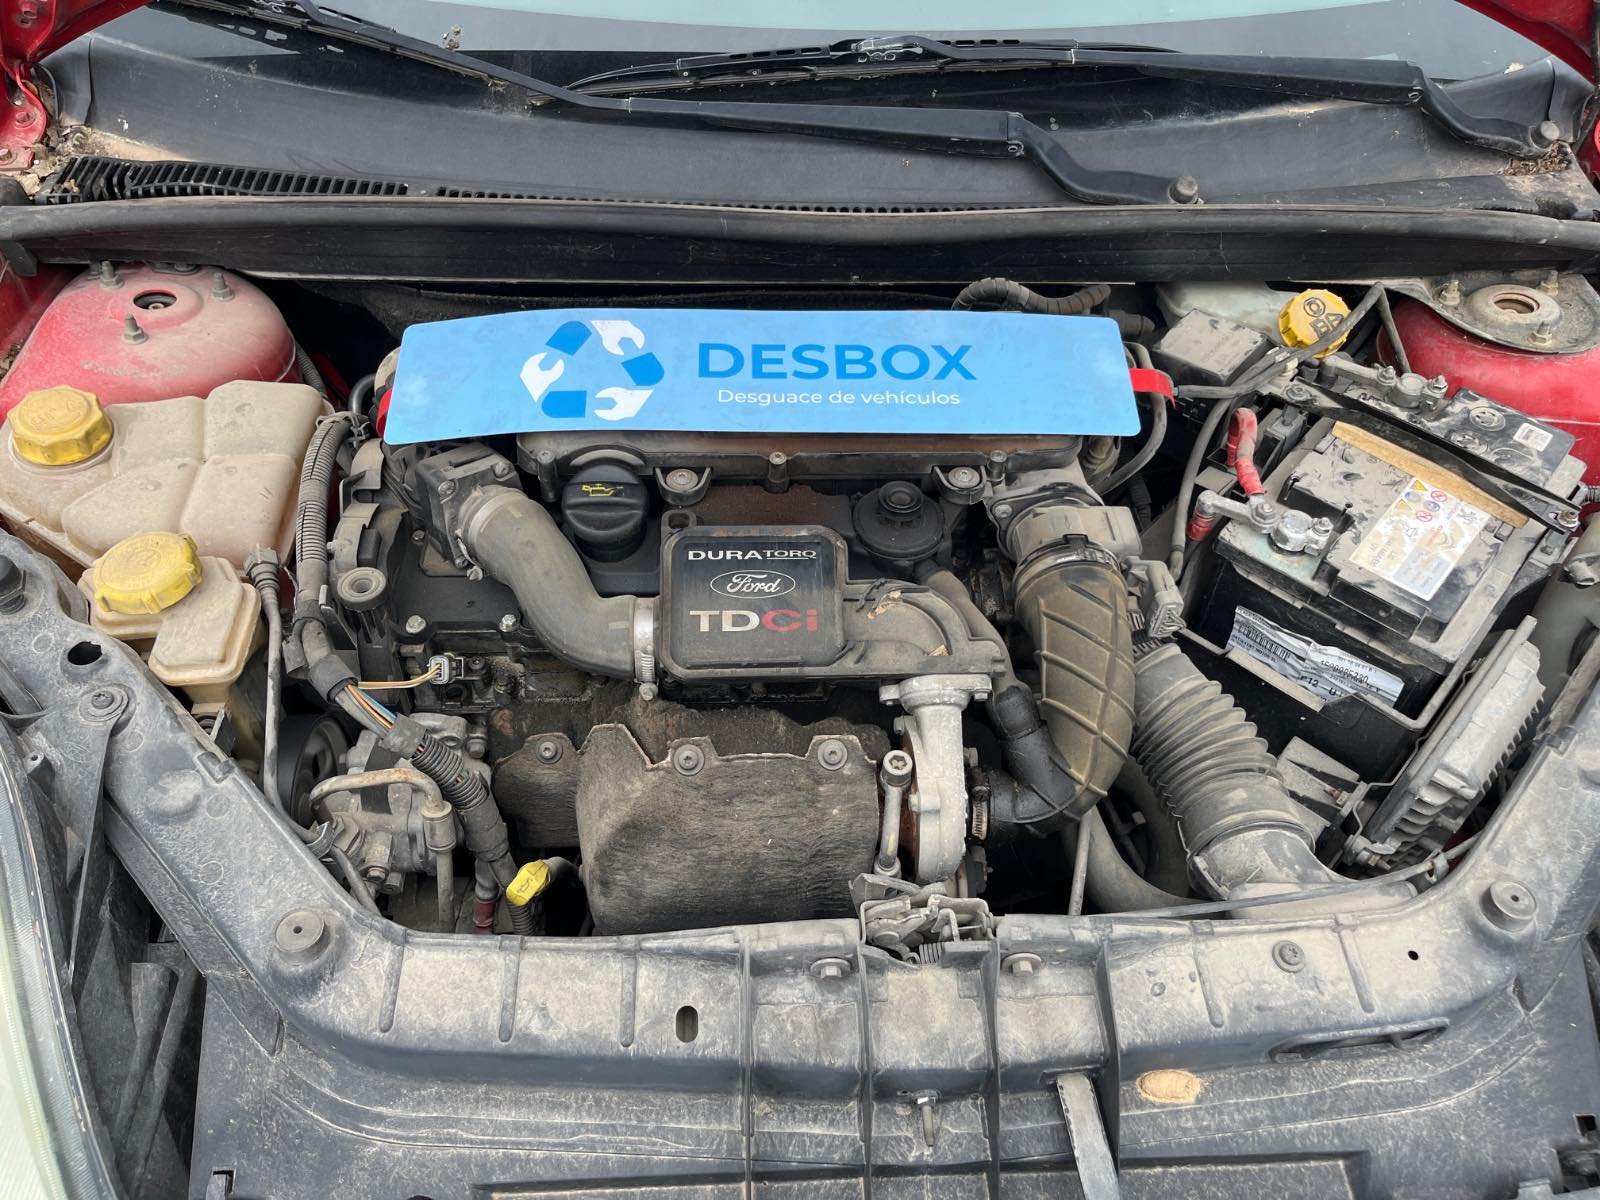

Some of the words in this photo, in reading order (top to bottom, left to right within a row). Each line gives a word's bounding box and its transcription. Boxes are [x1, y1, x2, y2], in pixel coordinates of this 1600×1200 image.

[698, 342, 977, 381] DESBOX
[718, 389, 823, 406] Desguace
[829, 389, 856, 405] de
[861, 389, 961, 406] vehículos
[687, 549, 817, 561] DURATORQ
[726, 572, 782, 594] Ford
[689, 608, 818, 633] TDCi
